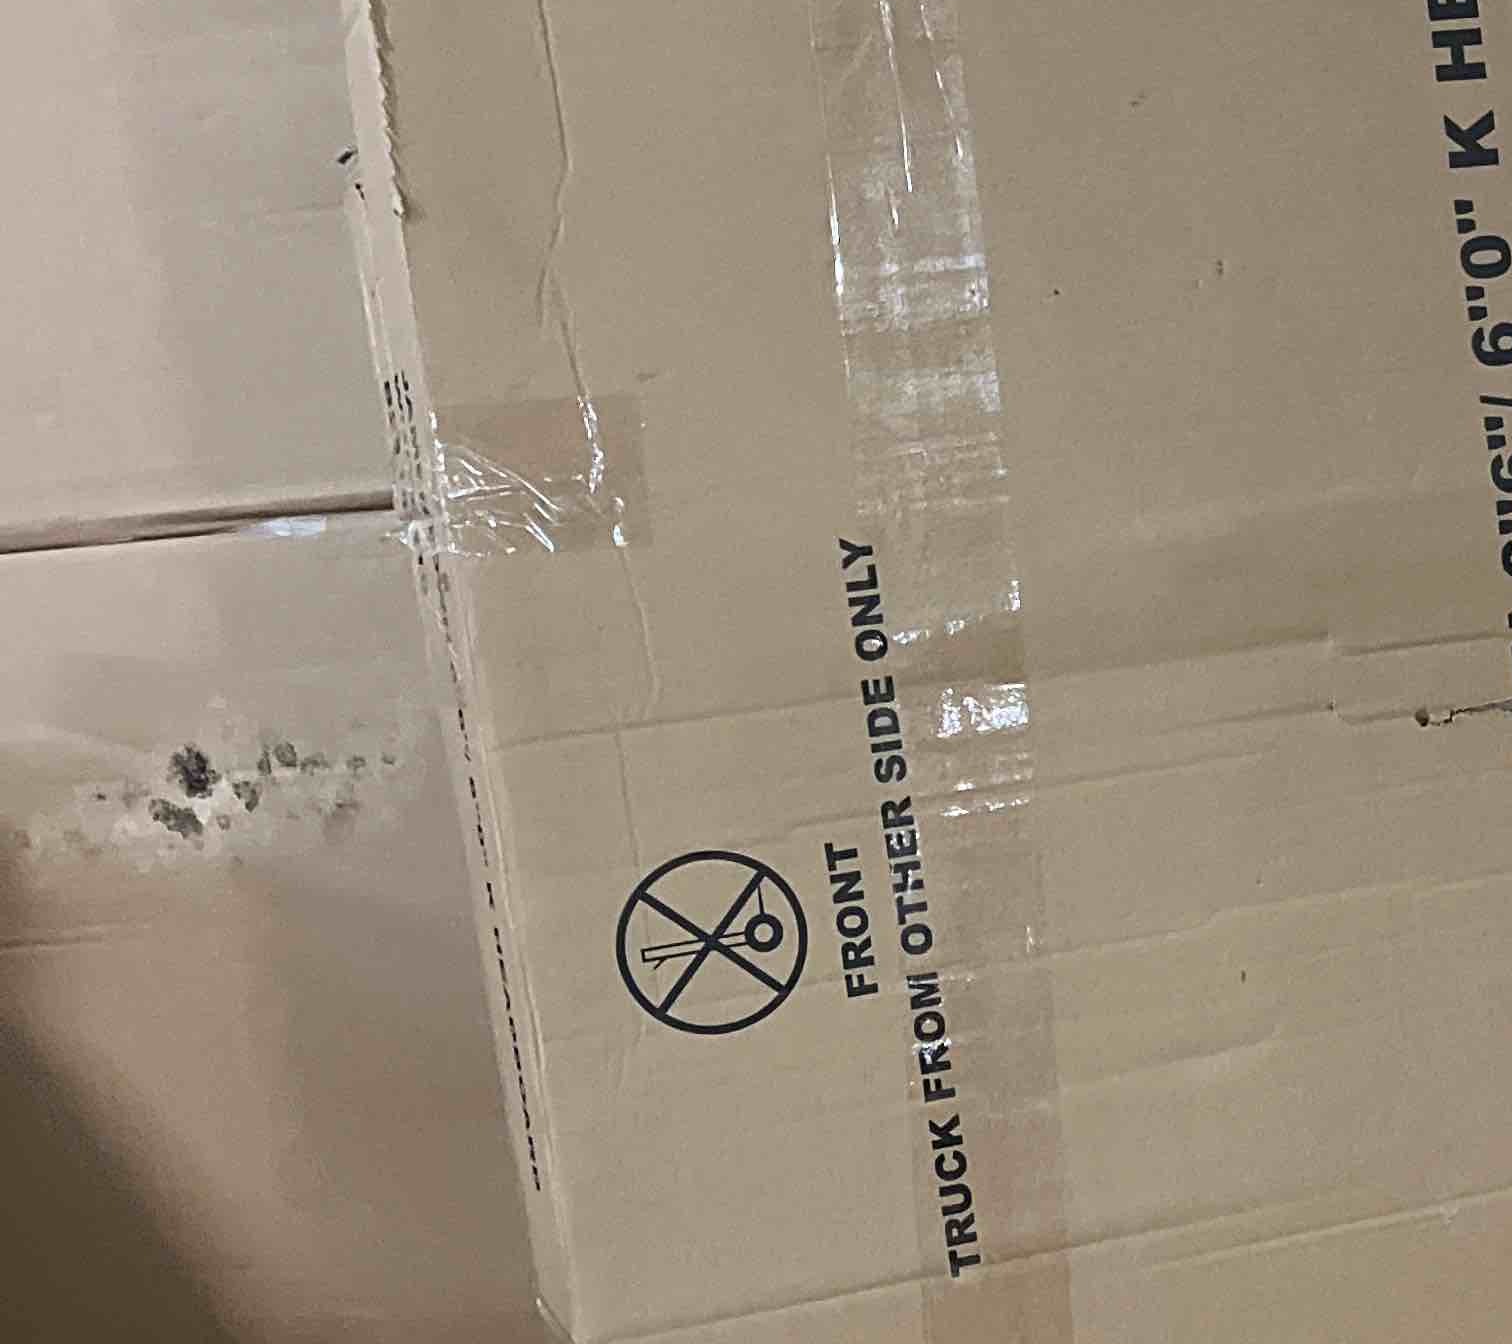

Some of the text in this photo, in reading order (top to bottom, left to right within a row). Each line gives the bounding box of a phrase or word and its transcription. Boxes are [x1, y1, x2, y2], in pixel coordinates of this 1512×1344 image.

[1444, 110, 1499, 168] K
[824, 842, 878, 998] FRONT
[839, 538, 981, 1278] TRUCK FROM OTHER SIDE ONLY
